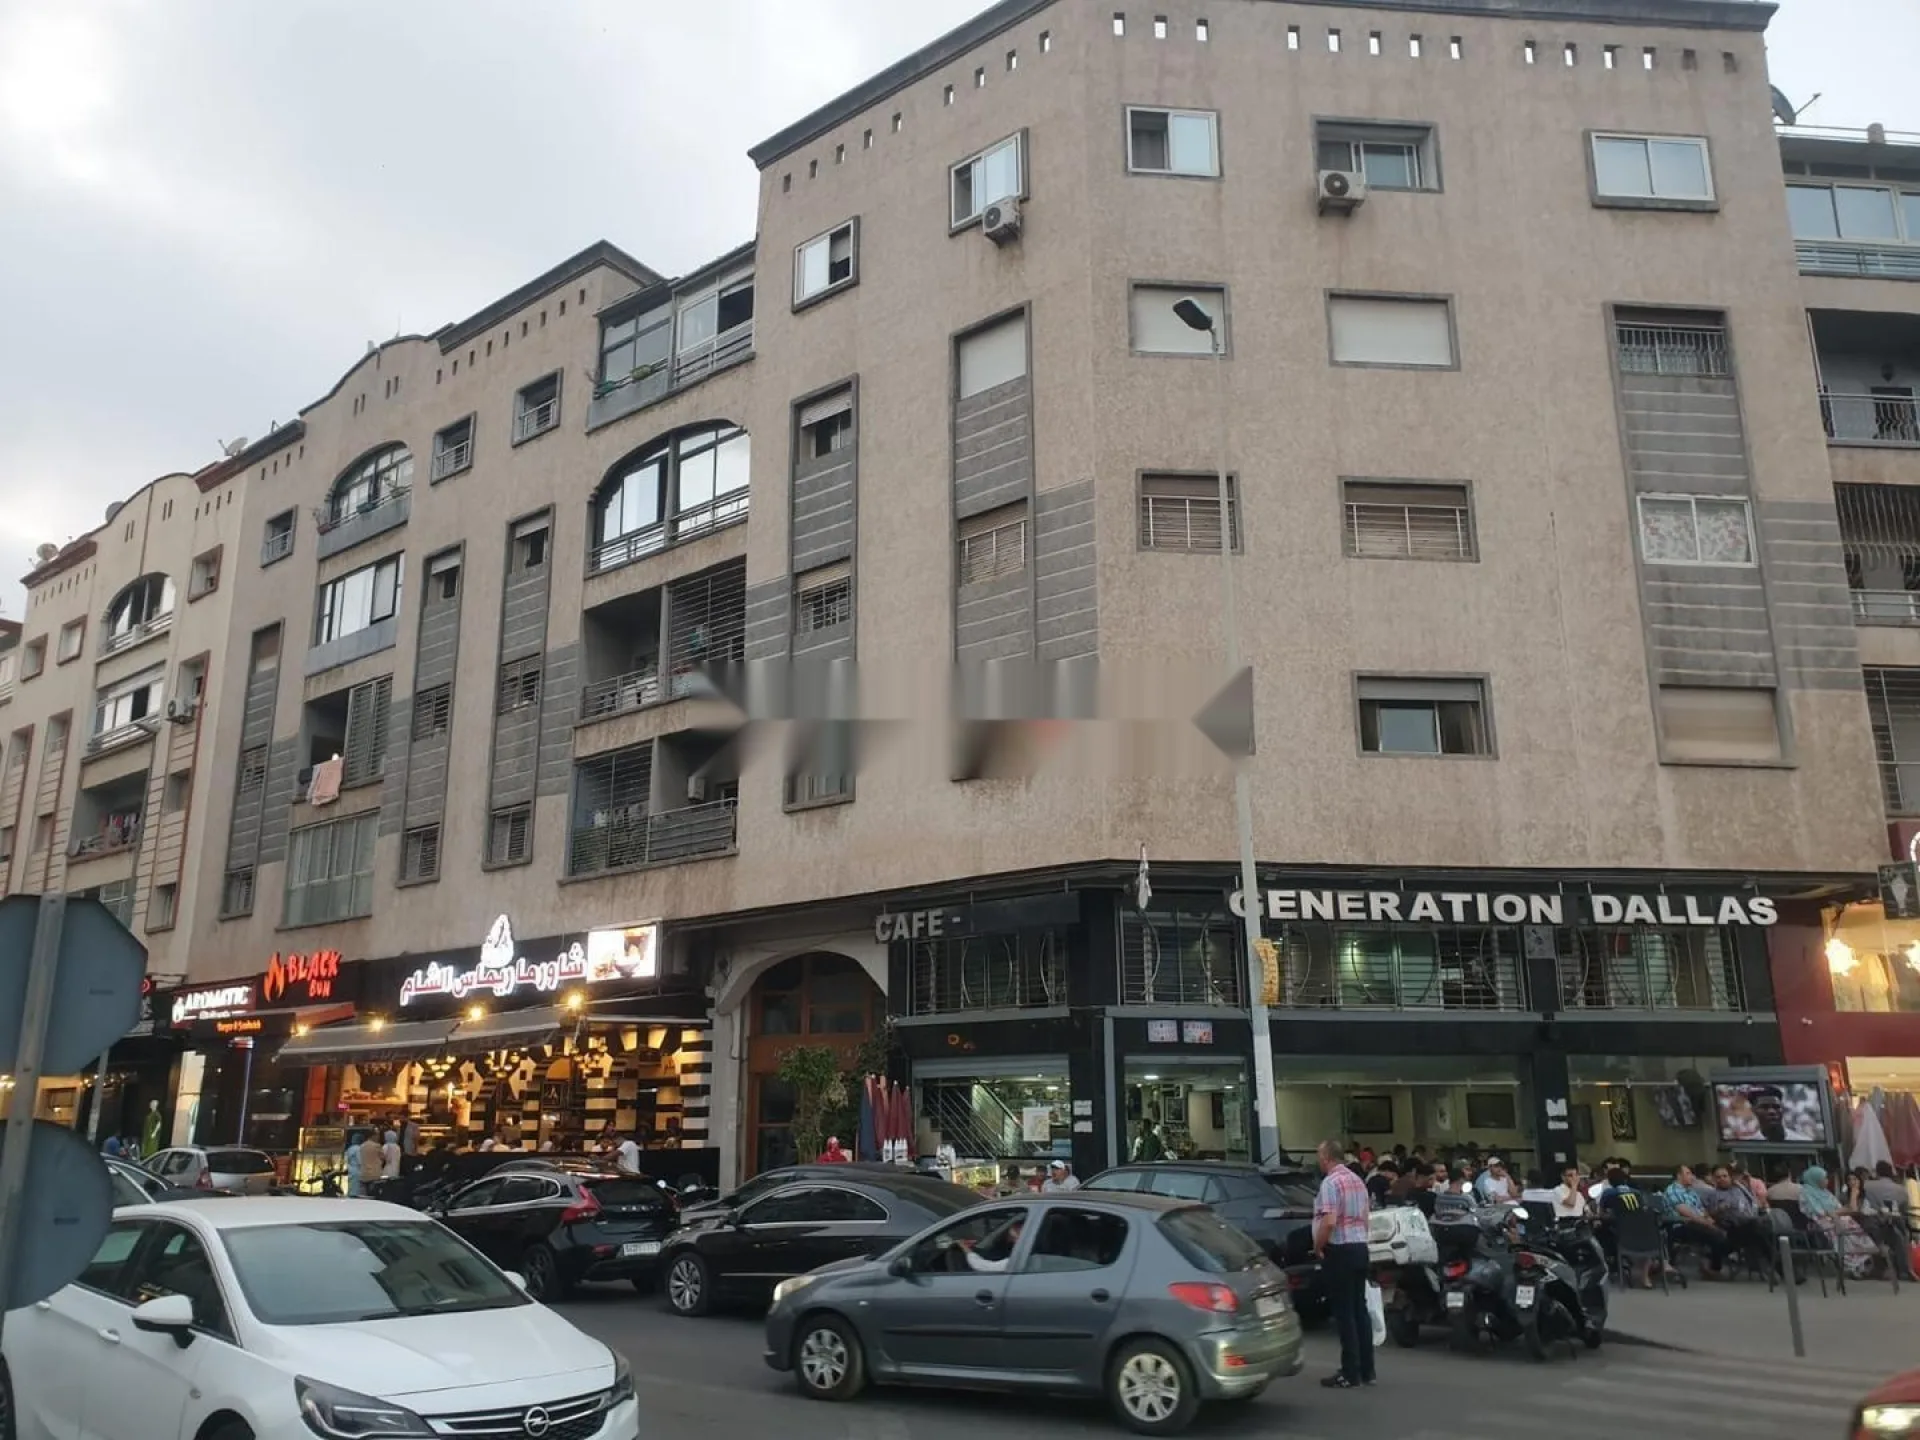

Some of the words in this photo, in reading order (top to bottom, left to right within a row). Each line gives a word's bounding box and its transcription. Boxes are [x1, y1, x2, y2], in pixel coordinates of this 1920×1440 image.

[875, 908, 945, 942] CAFE
[1229, 889, 1563, 924] GENERATION
[1591, 895, 1778, 925] DALLAS
[288, 951, 341, 983] BLACK
[400, 961, 453, 1006] الشام
[516, 942, 588, 991] شاورما
